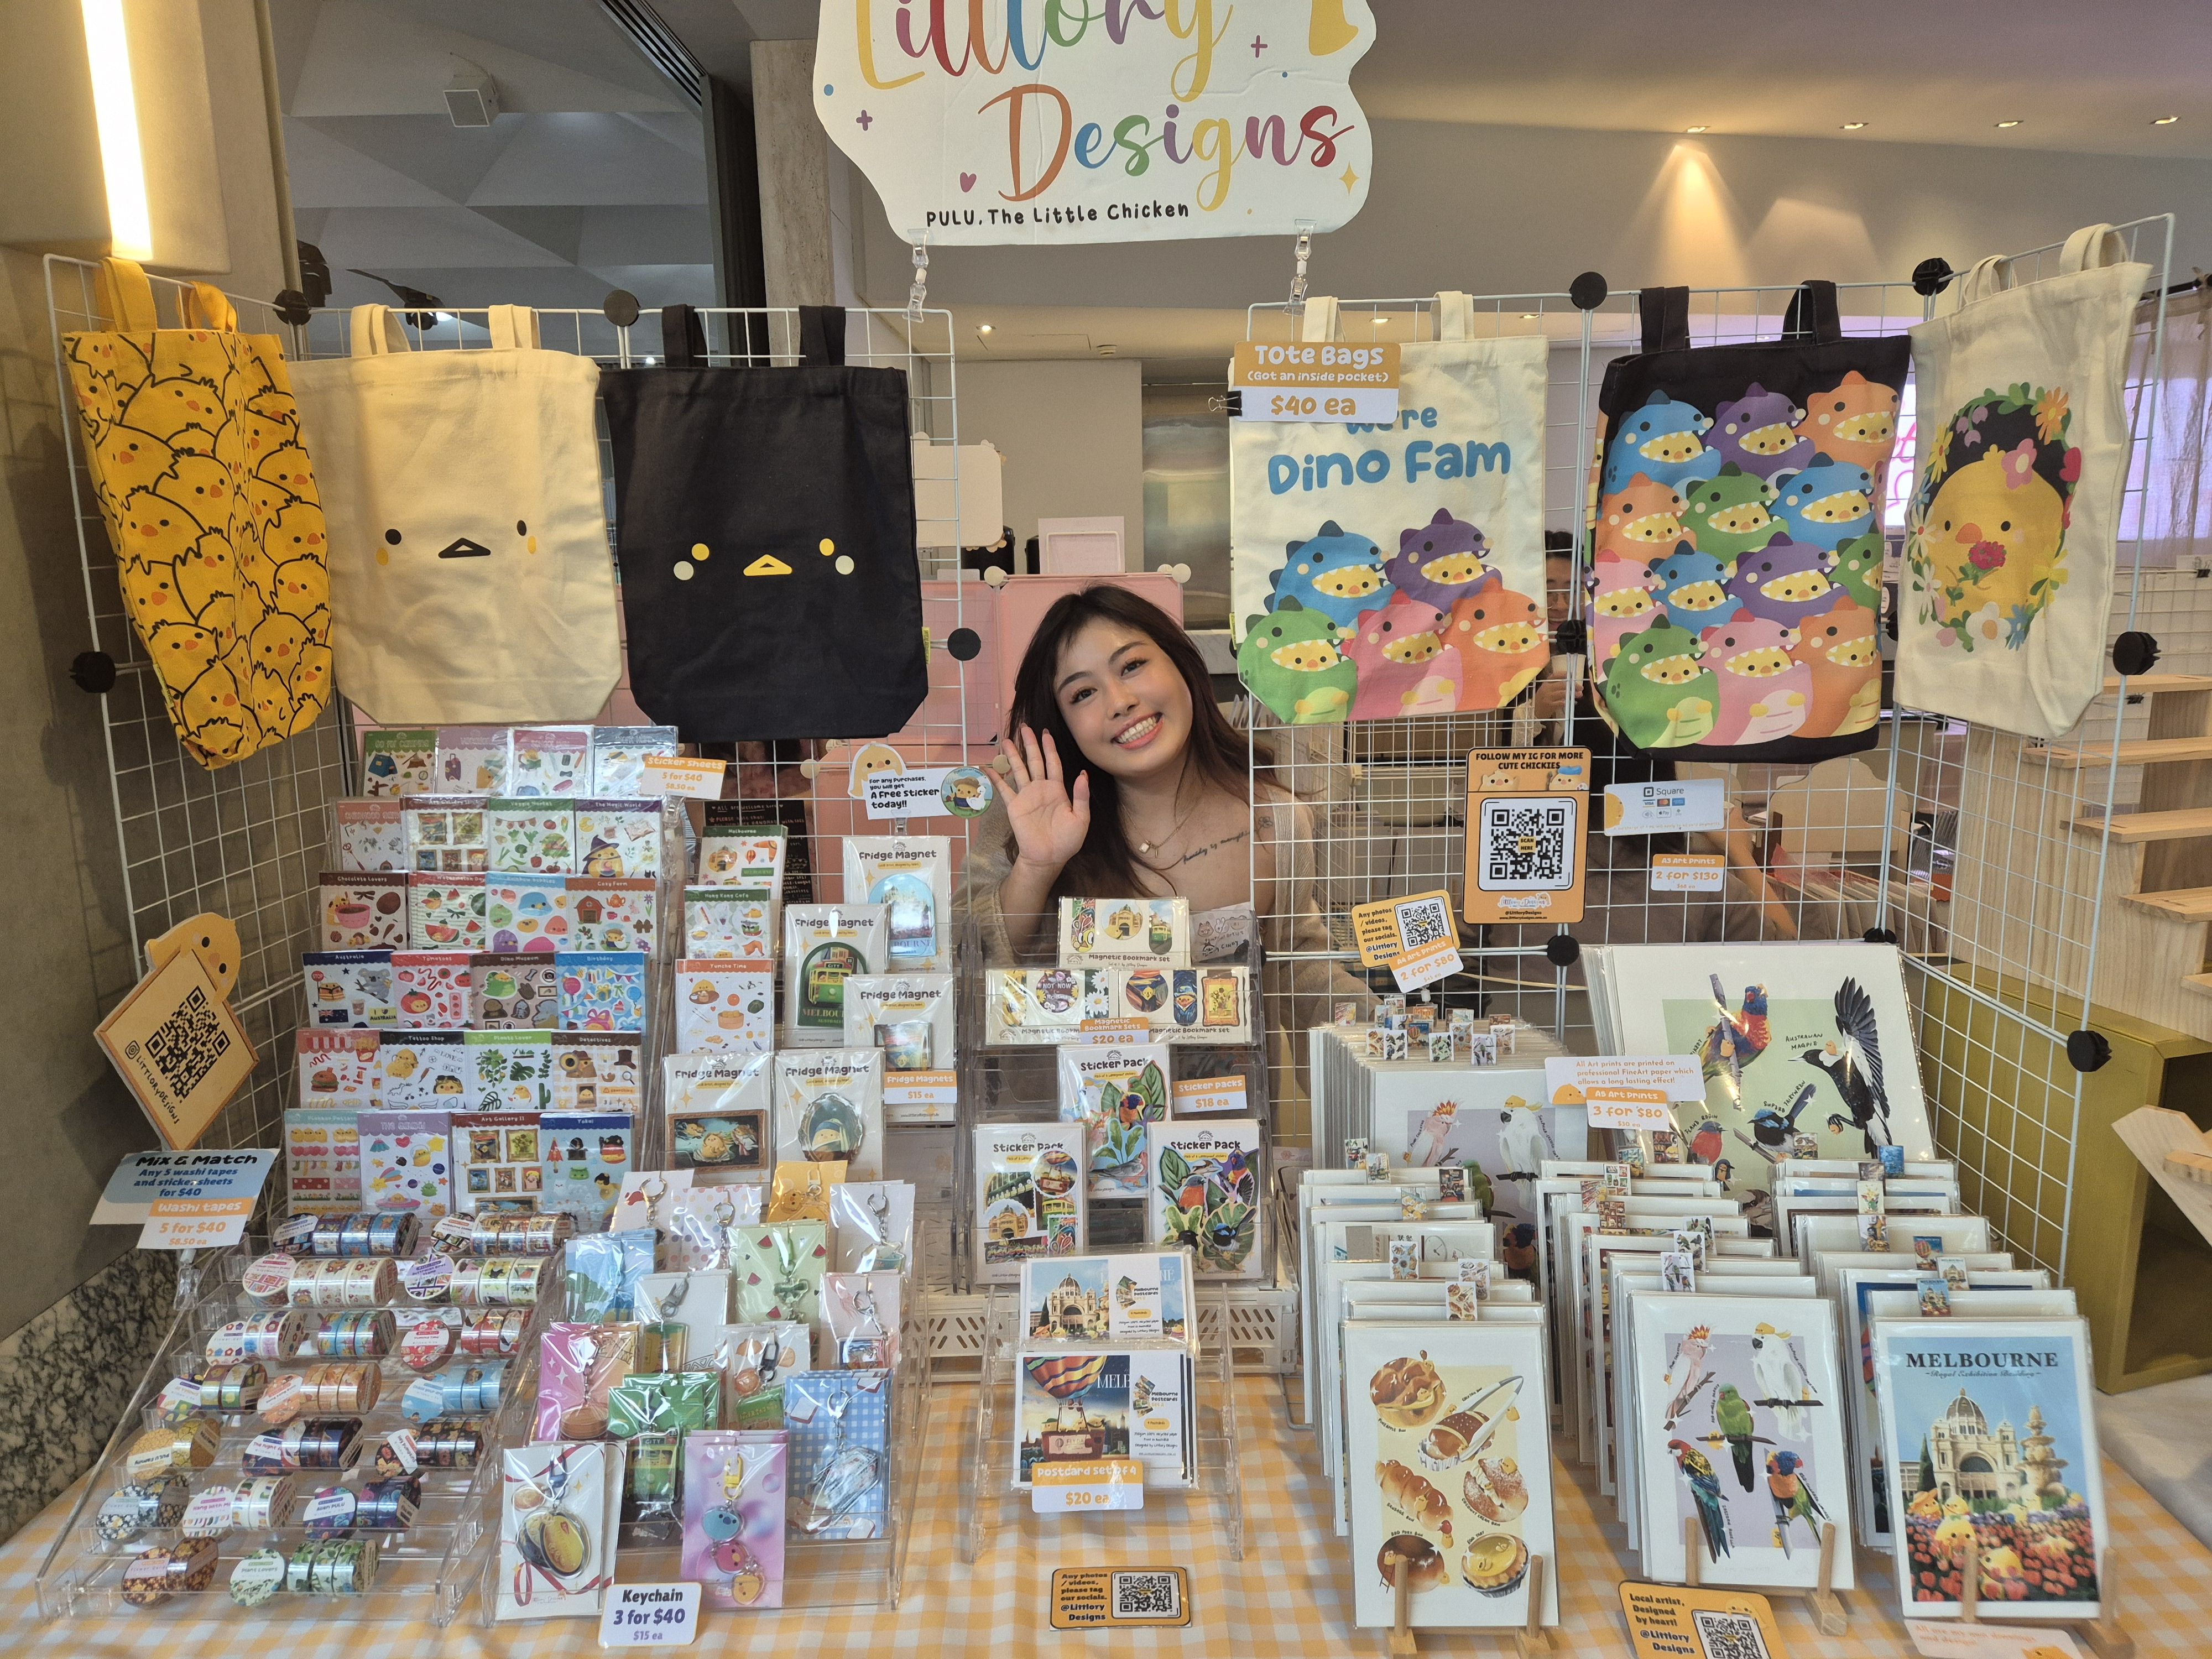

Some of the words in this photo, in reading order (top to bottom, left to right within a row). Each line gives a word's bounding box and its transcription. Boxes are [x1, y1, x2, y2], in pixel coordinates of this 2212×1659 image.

[978, 84, 1354, 211] Designs
[987, 209, 1024, 225] The
[1033, 205, 1098, 223] Little
[1107, 200, 1189, 220] Chicken
[1321, 346, 1384, 370] Bags
[1248, 371, 1276, 381] (Got
[1280, 372, 1295, 381] an
[1298, 372, 1334, 382] inside
[1337, 372, 1388, 383] pocket)
[1271, 395, 1317, 416] $40
[1324, 397, 1356, 415] ea
[1267, 449, 1390, 495] Dino
[1405, 440, 1511, 483] Fam
[648, 757, 685, 766] Sticker
[687, 760, 723, 769] sheets
[1498, 761, 1518, 770] CUTE
[1520, 761, 1561, 769] CHICKIES
[684, 773, 702, 781] $40
[879, 790, 901, 799] Free
[1656, 787, 1684, 796] Square
[872, 800, 907, 809] today!!
[859, 851, 893, 860] Fridge
[896, 850, 937, 860] Magnet
[1666, 870, 1691, 880] for
[1693, 870, 1719, 880] $130
[1371, 908, 1392, 917] photos
[795, 919, 829, 928] Fridge
[830, 919, 874, 928] agnet
[1366, 942, 1397, 952] @Littlory
[1400, 972, 1408, 980] 2
[1411, 962, 1432, 977] for
[1434, 953, 1454, 967] $80
[860, 990, 896, 1001] Fridge
[899, 989, 941, 1000] Magnet
[1093, 1035, 1114, 1044] $20
[1791, 1041, 1818, 1050] MAGPIE
[1601, 1060, 1621, 1068] prints
[1637, 1060, 1664, 1068] printed
[675, 1070, 712, 1080] Fridge
[714, 1069, 759, 1079] Magnet
[785, 1066, 823, 1077] Fridge
[825, 1065, 869, 1074] Magnet
[886, 1074, 914, 1084] Fridge
[916, 1074, 953, 1084] Magnets
[907, 1091, 920, 1100] $15
[921, 1091, 935, 1099] ea
[1196, 1098, 1214, 1109] $18
[1593, 1106, 1601, 1115] 3
[1606, 1105, 1633, 1116] for
[1637, 1107, 1663, 1118] $80
[993, 1142, 1035, 1152] Sticker
[1171, 1141, 1212, 1150] Sticker
[1214, 1141, 1240, 1150] Pack
[136, 1156, 171, 1167] Mix
[174, 1155, 189, 1165] &
[191, 1155, 258, 1165] Match
[159, 1223, 169, 1234] 5
[172, 1223, 194, 1233] for
[196, 1222, 226, 1234] $40
[1906, 1353, 2058, 1367] MELBOURNE
[1066, 1491, 1091, 1506] $20
[1095, 1493, 1110, 1504] ea
[622, 1589, 683, 1605] Keychain
[1629, 1593, 1653, 1603] Local
[1632, 1604, 1676, 1616] Designed
[613, 1610, 624, 1625] 3
[628, 1609, 650, 1624] for
[653, 1607, 685, 1626] $40
[633, 1630, 650, 1640] $15
[1640, 1629, 1689, 1643] @Littlory
[1652, 1642, 1695, 1654] Designs
